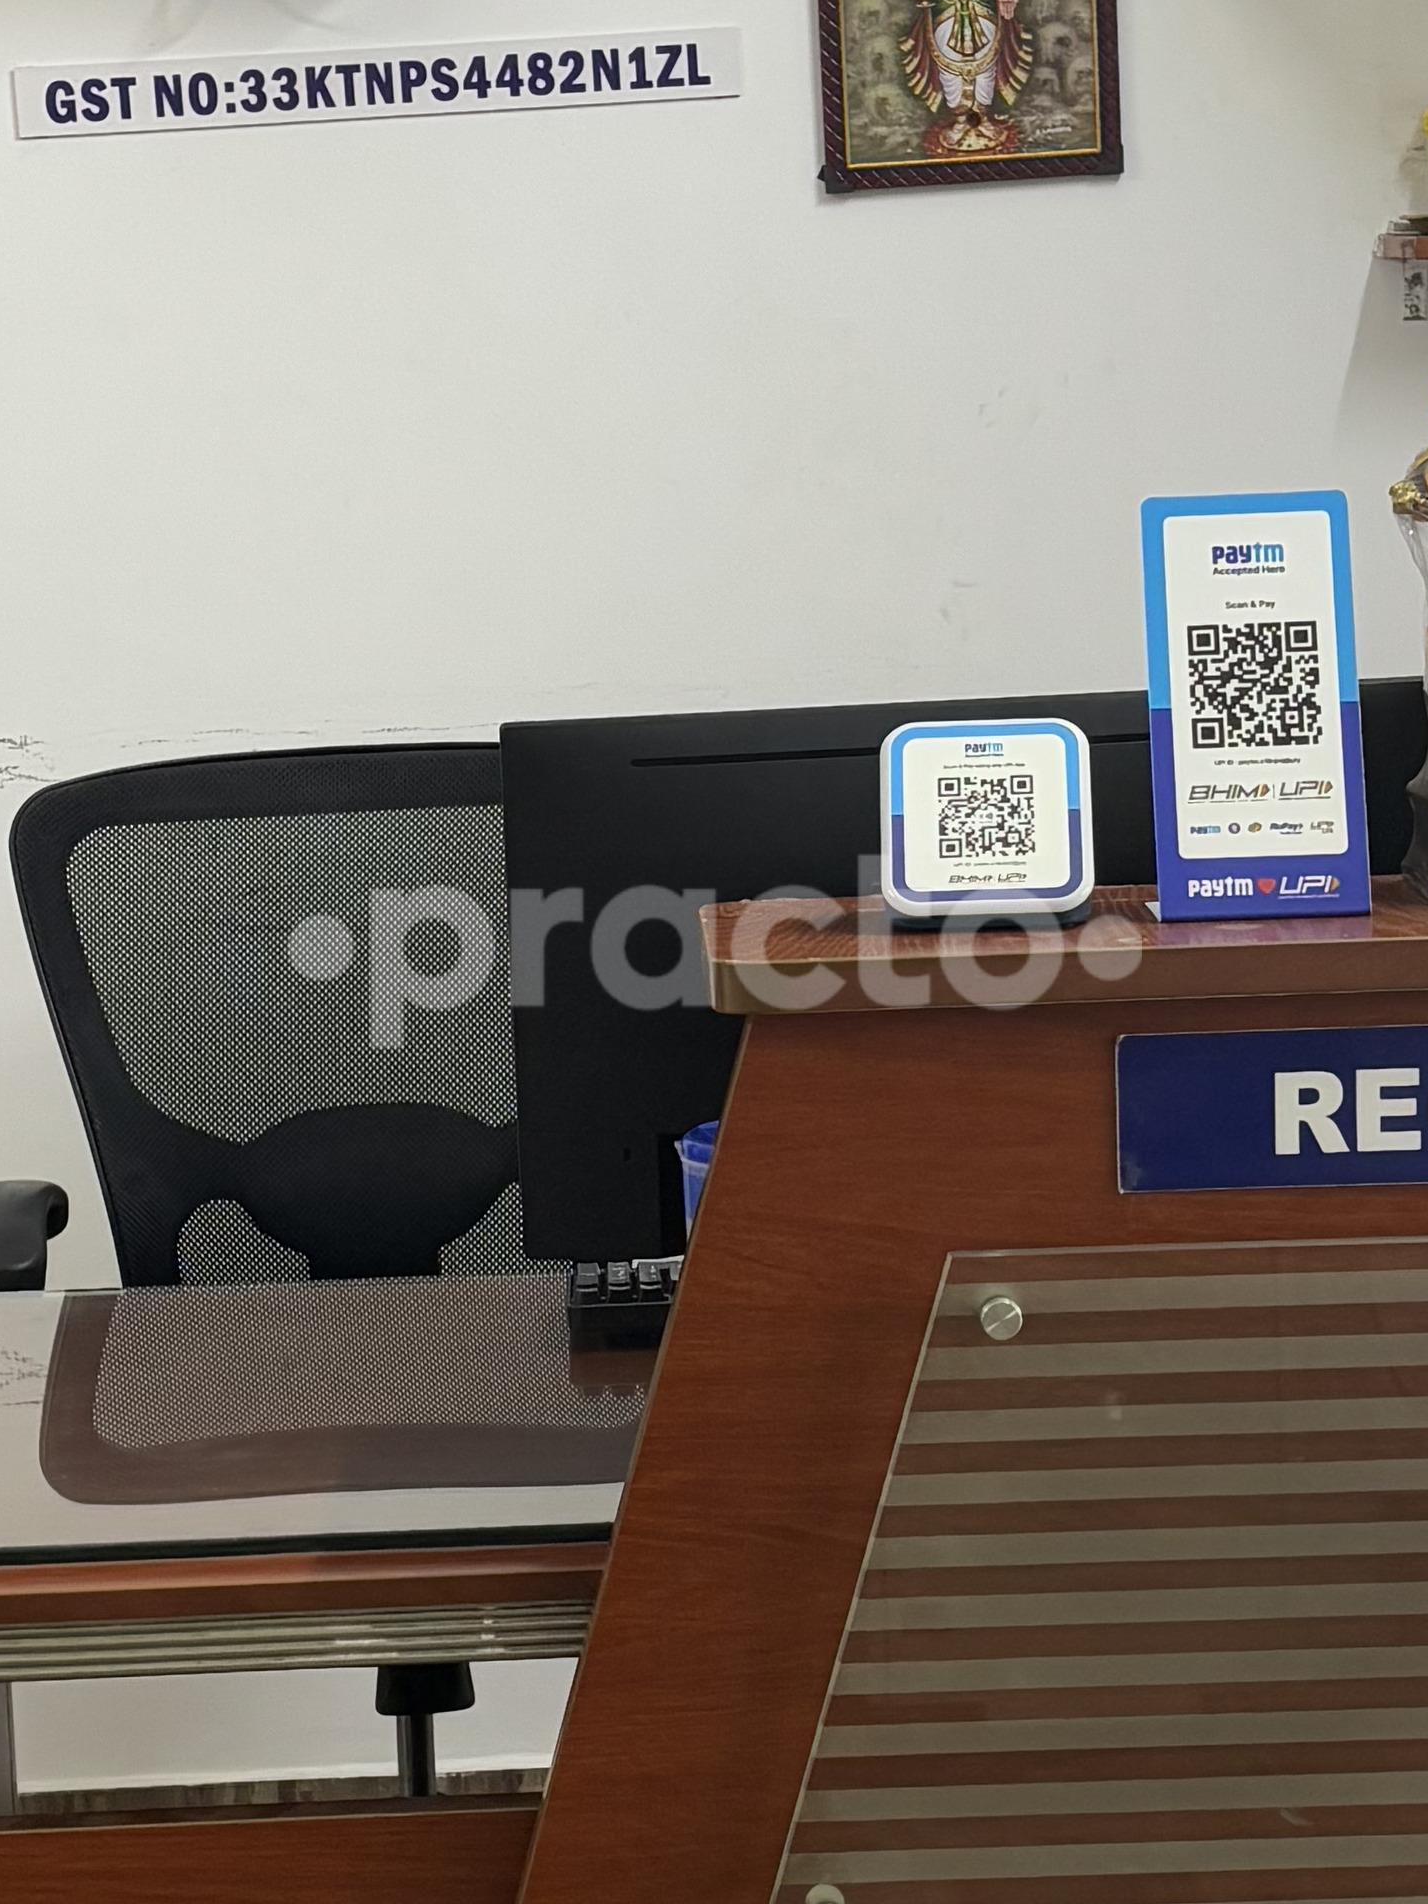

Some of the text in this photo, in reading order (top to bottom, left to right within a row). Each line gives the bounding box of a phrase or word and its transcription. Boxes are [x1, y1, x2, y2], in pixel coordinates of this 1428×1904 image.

[45, 43, 711, 124] GST NO:33KTNPS4482N1ZL
[1213, 566, 1260, 576] Accepted
[1225, 601, 1248, 609] Scan
[1259, 600, 1276, 609] Pay
[1188, 780, 1325, 801] BHIM UPI
[1278, 875, 1333, 895] UPI
